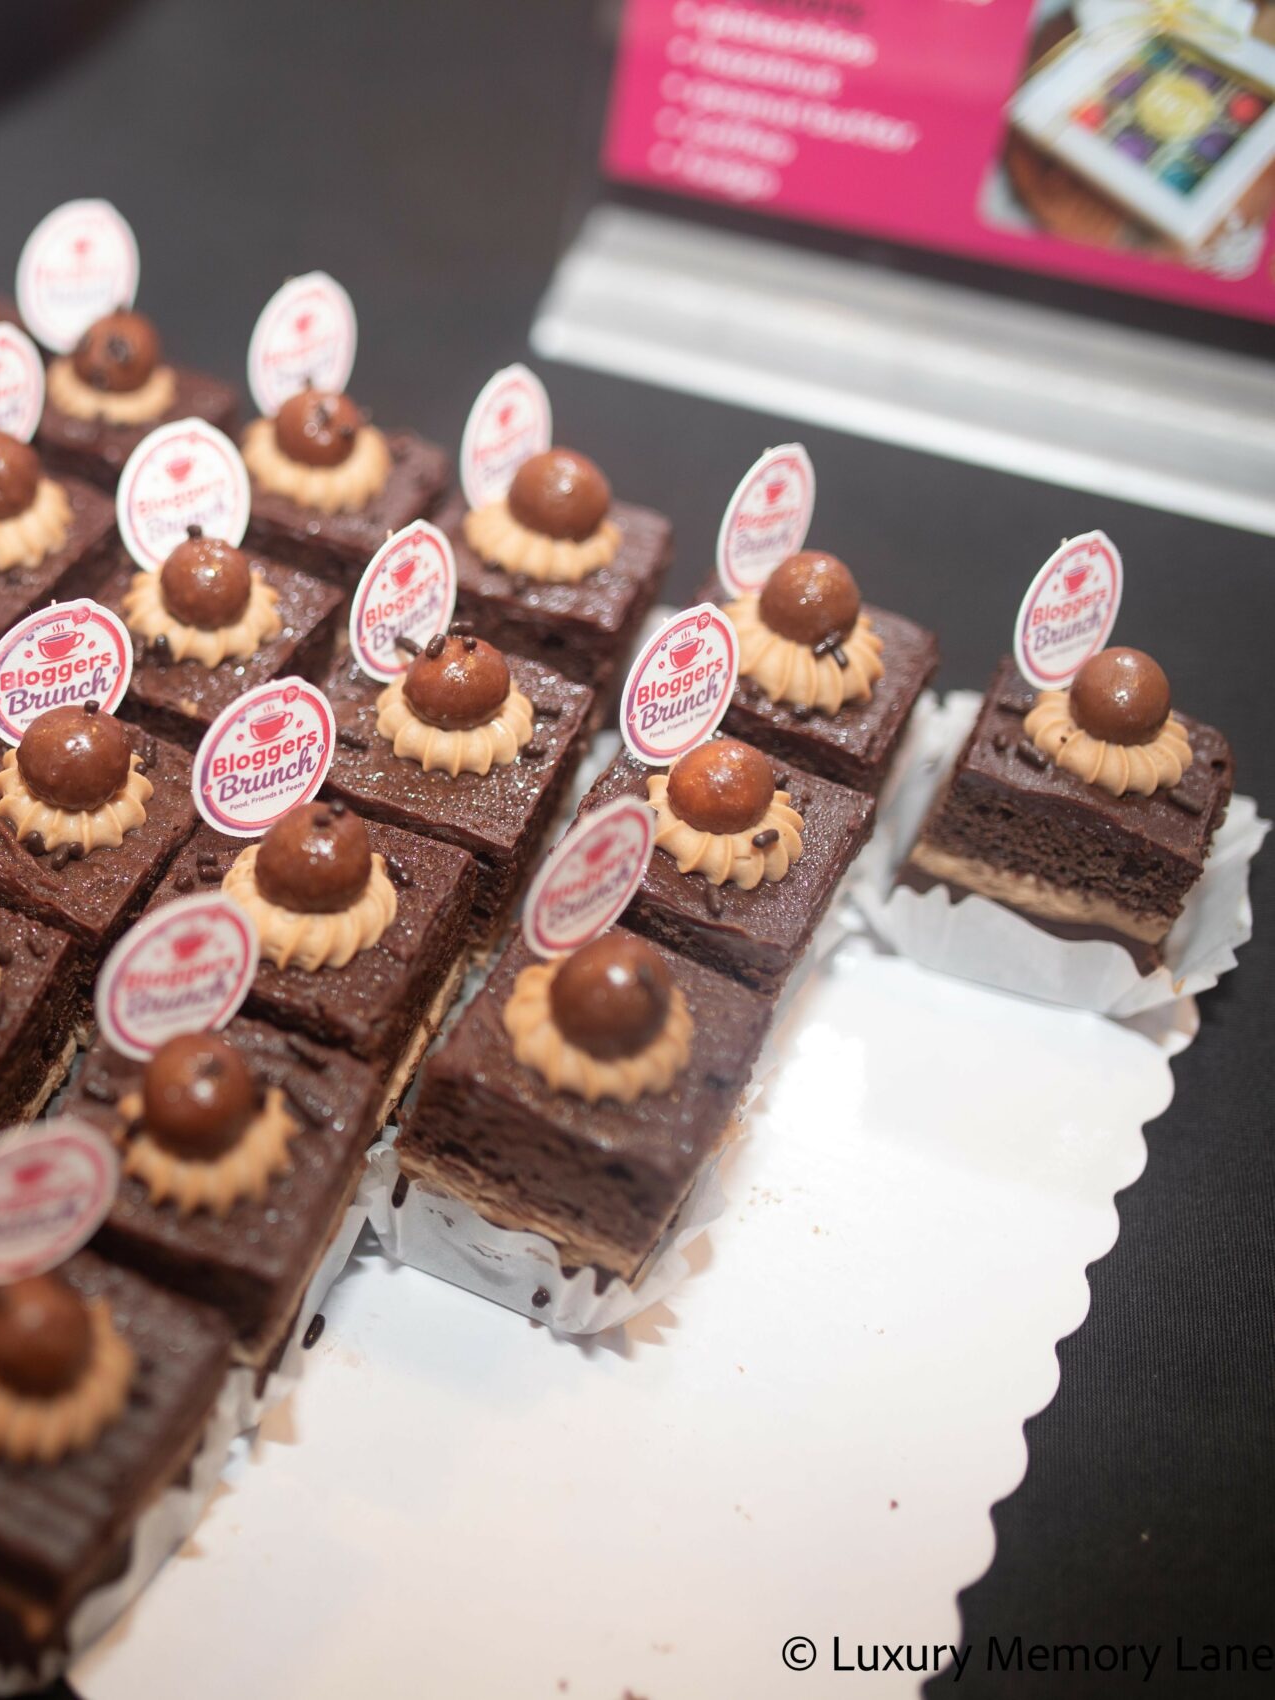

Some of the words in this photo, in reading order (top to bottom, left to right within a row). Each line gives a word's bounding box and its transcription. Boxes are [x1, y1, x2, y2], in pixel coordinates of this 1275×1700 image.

[365, 572, 440, 628] Bloggers
[1033, 588, 1107, 626] Bloggers
[1033, 601, 1103, 651] Brunch
[0, 652, 112, 691] Bloggers
[5, 667, 112, 716] Brunch
[637, 657, 723, 706] Bloggers
[639, 673, 721, 731] Brunch
[212, 730, 318, 777] Bloggers
[216, 746, 316, 802] Brunch
